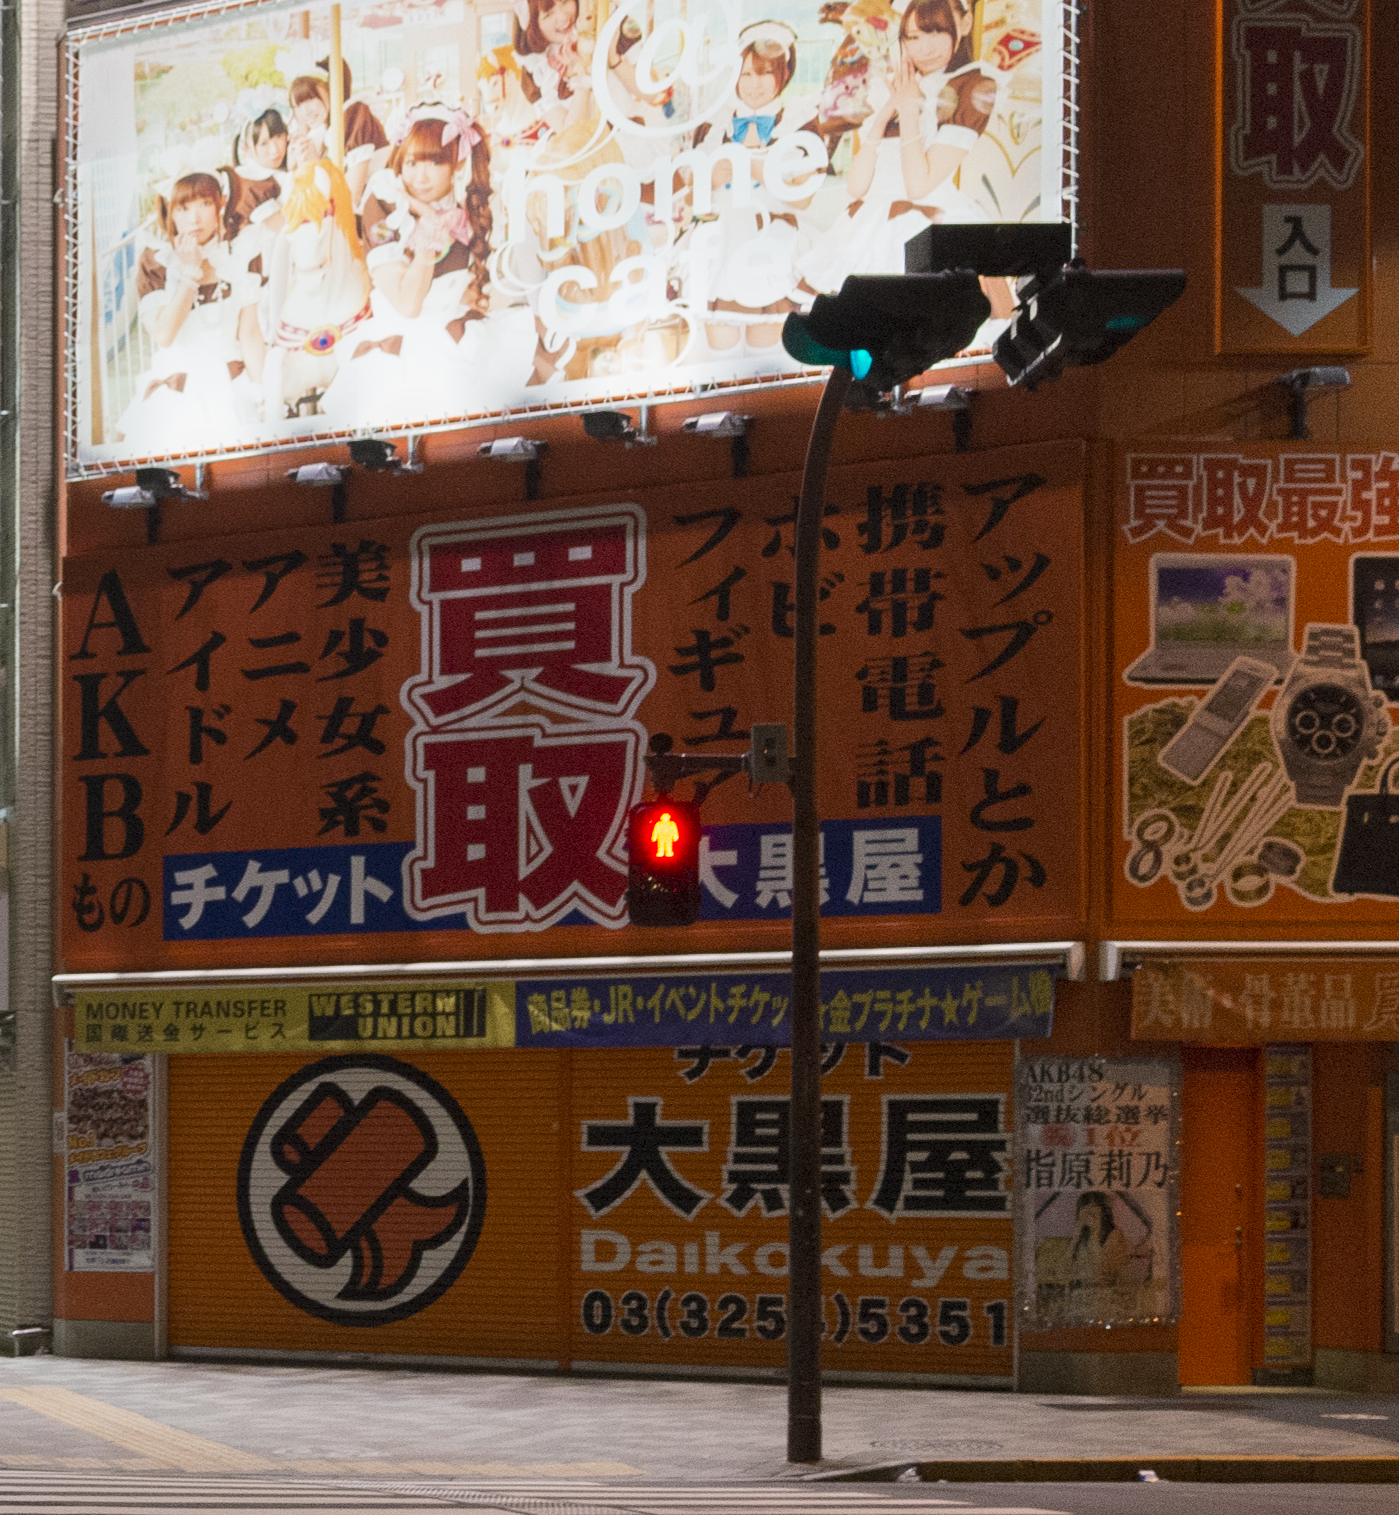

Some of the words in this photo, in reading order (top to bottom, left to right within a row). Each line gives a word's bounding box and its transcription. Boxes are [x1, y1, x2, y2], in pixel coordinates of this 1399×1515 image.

[506, 130, 830, 248] home
[1275, 215, 1322, 304] 入口
[241, 549, 310, 760] アニメ
[855, 482, 946, 809] 携帯電話
[164, 559, 234, 837] アイドル
[316, 539, 391, 837] 美少女系
[401, 503, 657, 935] 買取
[959, 472, 1054, 908] アップルとか
[71, 872, 151, 933] もの
[170, 853, 395, 931] チケット
[85, 1001, 164, 1021] MONEY
[173, 998, 288, 1020] TRANSFER
[85, 1022, 288, 1043] 国際送金サービス
[310, 989, 457, 1017] WESTERN
[357, 1014, 457, 1038] UNION
[1025, 1062, 1105, 1084] AKB48
[574, 1095, 1013, 1223] 大黒屋
[1024, 1148, 1170, 1189] 指原莉乃
[580, 1228, 1011, 1287] Daikokuya
[580, 1286, 1009, 1348] 03(325)5351
